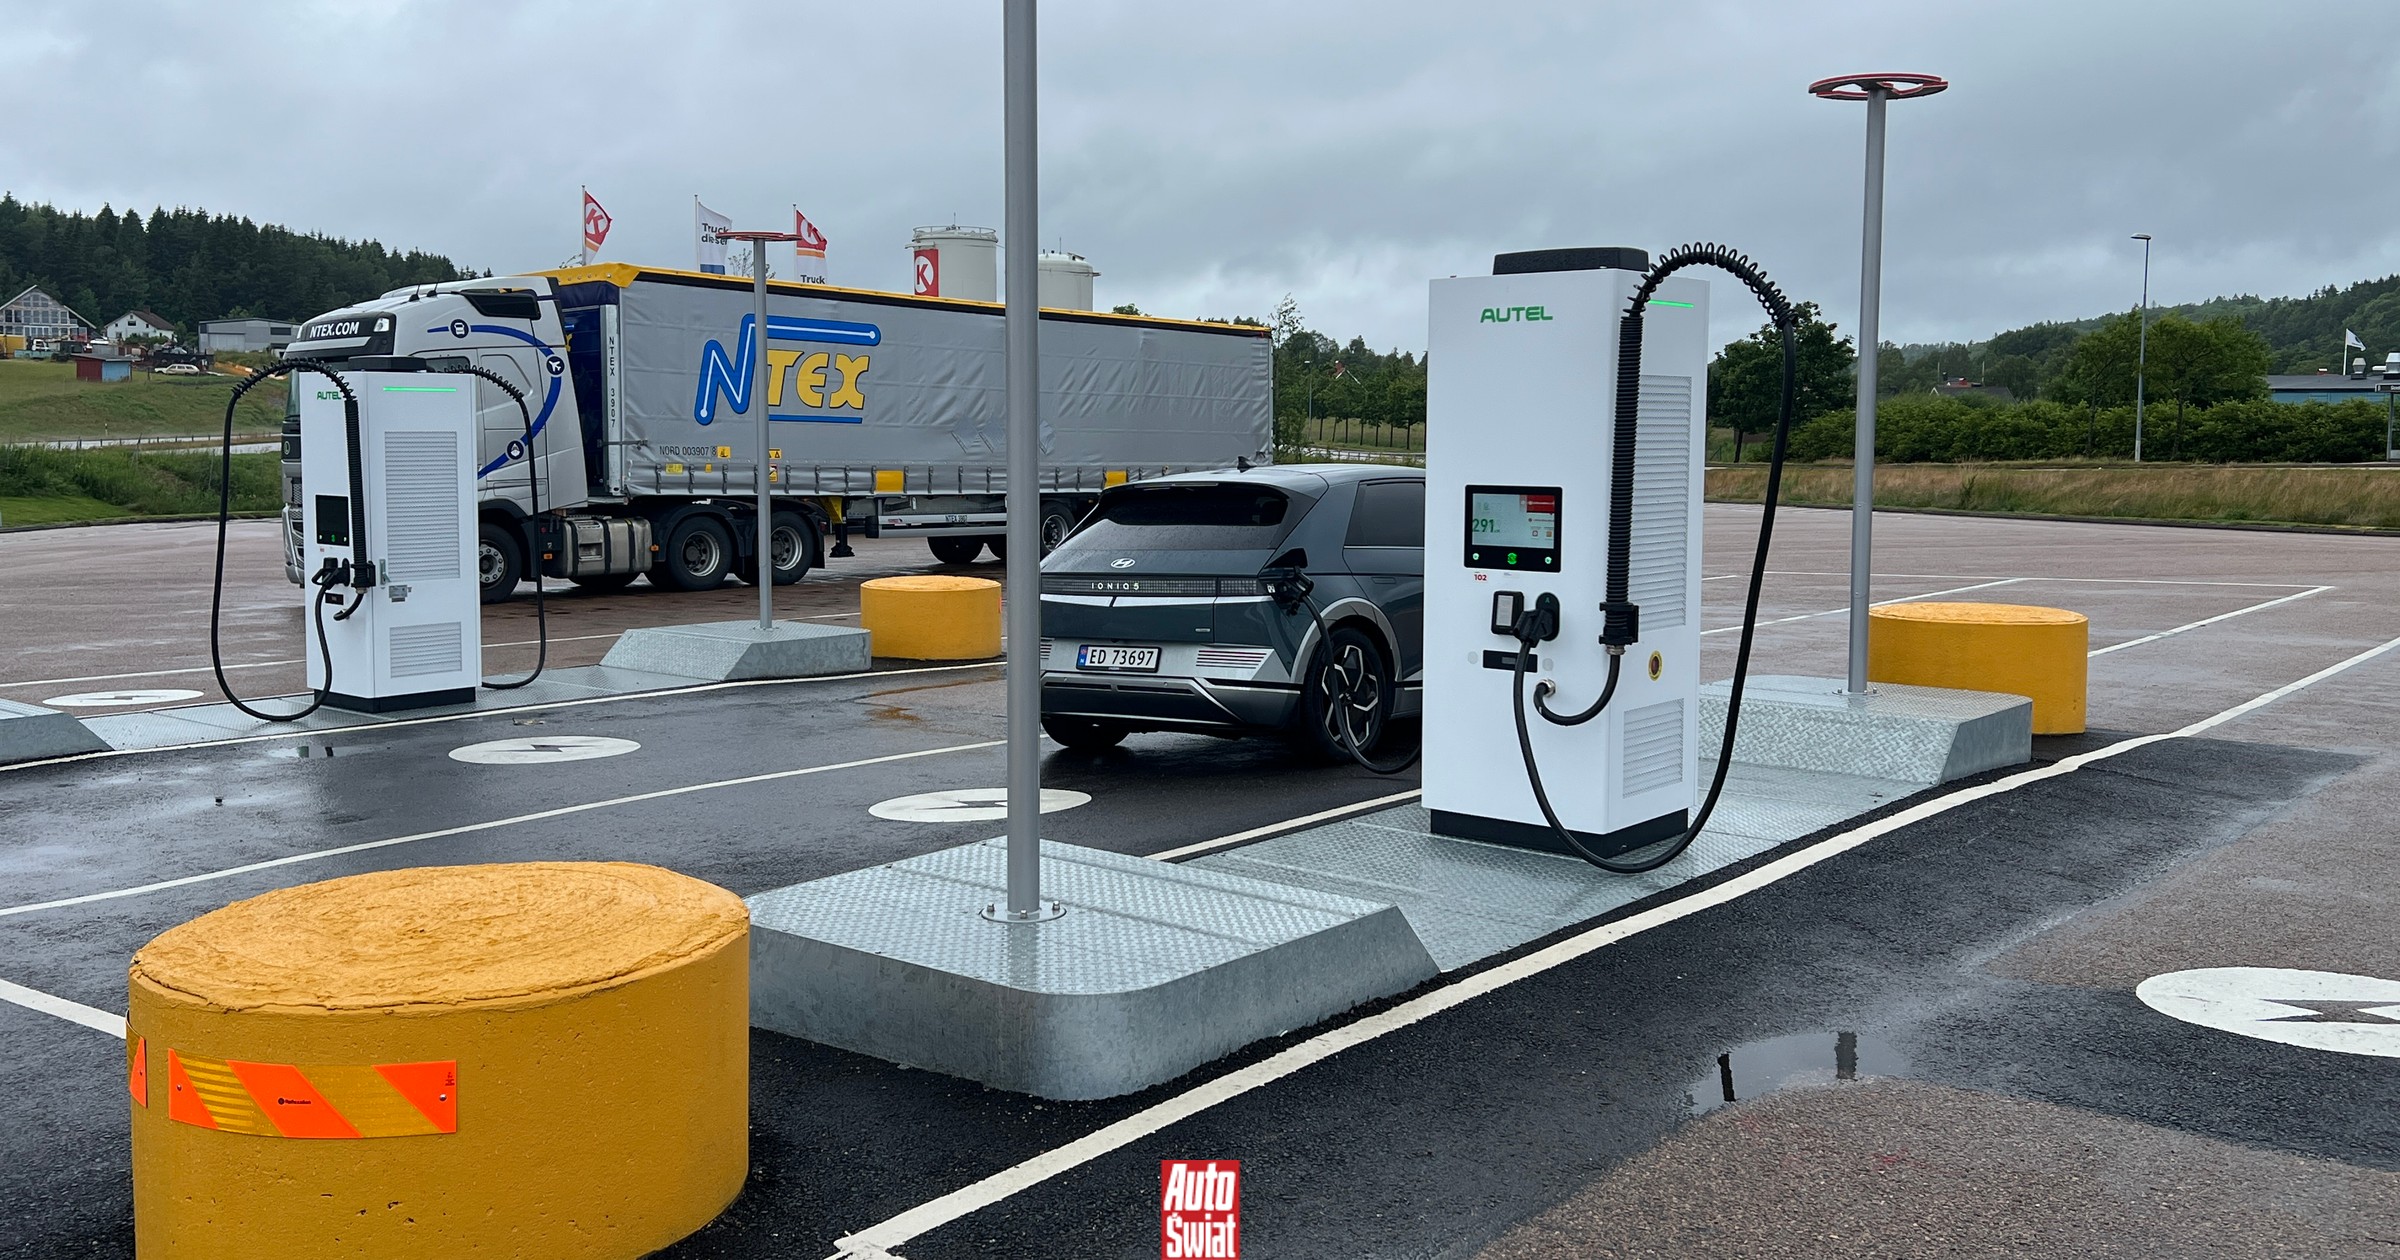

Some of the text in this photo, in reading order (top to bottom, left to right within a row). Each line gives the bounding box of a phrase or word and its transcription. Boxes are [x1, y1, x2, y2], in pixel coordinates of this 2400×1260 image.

[586, 207, 604, 234] K
[702, 222, 729, 233] Truck
[800, 274, 825, 284] Truck
[916, 264, 932, 291] K
[1480, 306, 1553, 323] AUTEL
[309, 321, 360, 339] NTEX.COM
[694, 313, 881, 425] NTEX
[316, 390, 342, 401] AUTEL
[659, 445, 680, 455] NORD
[682, 446, 709, 456] 003907
[1472, 518, 1495, 533] 291
[1474, 573, 1487, 581] 102
[1089, 649, 1154, 666] ED 73697
